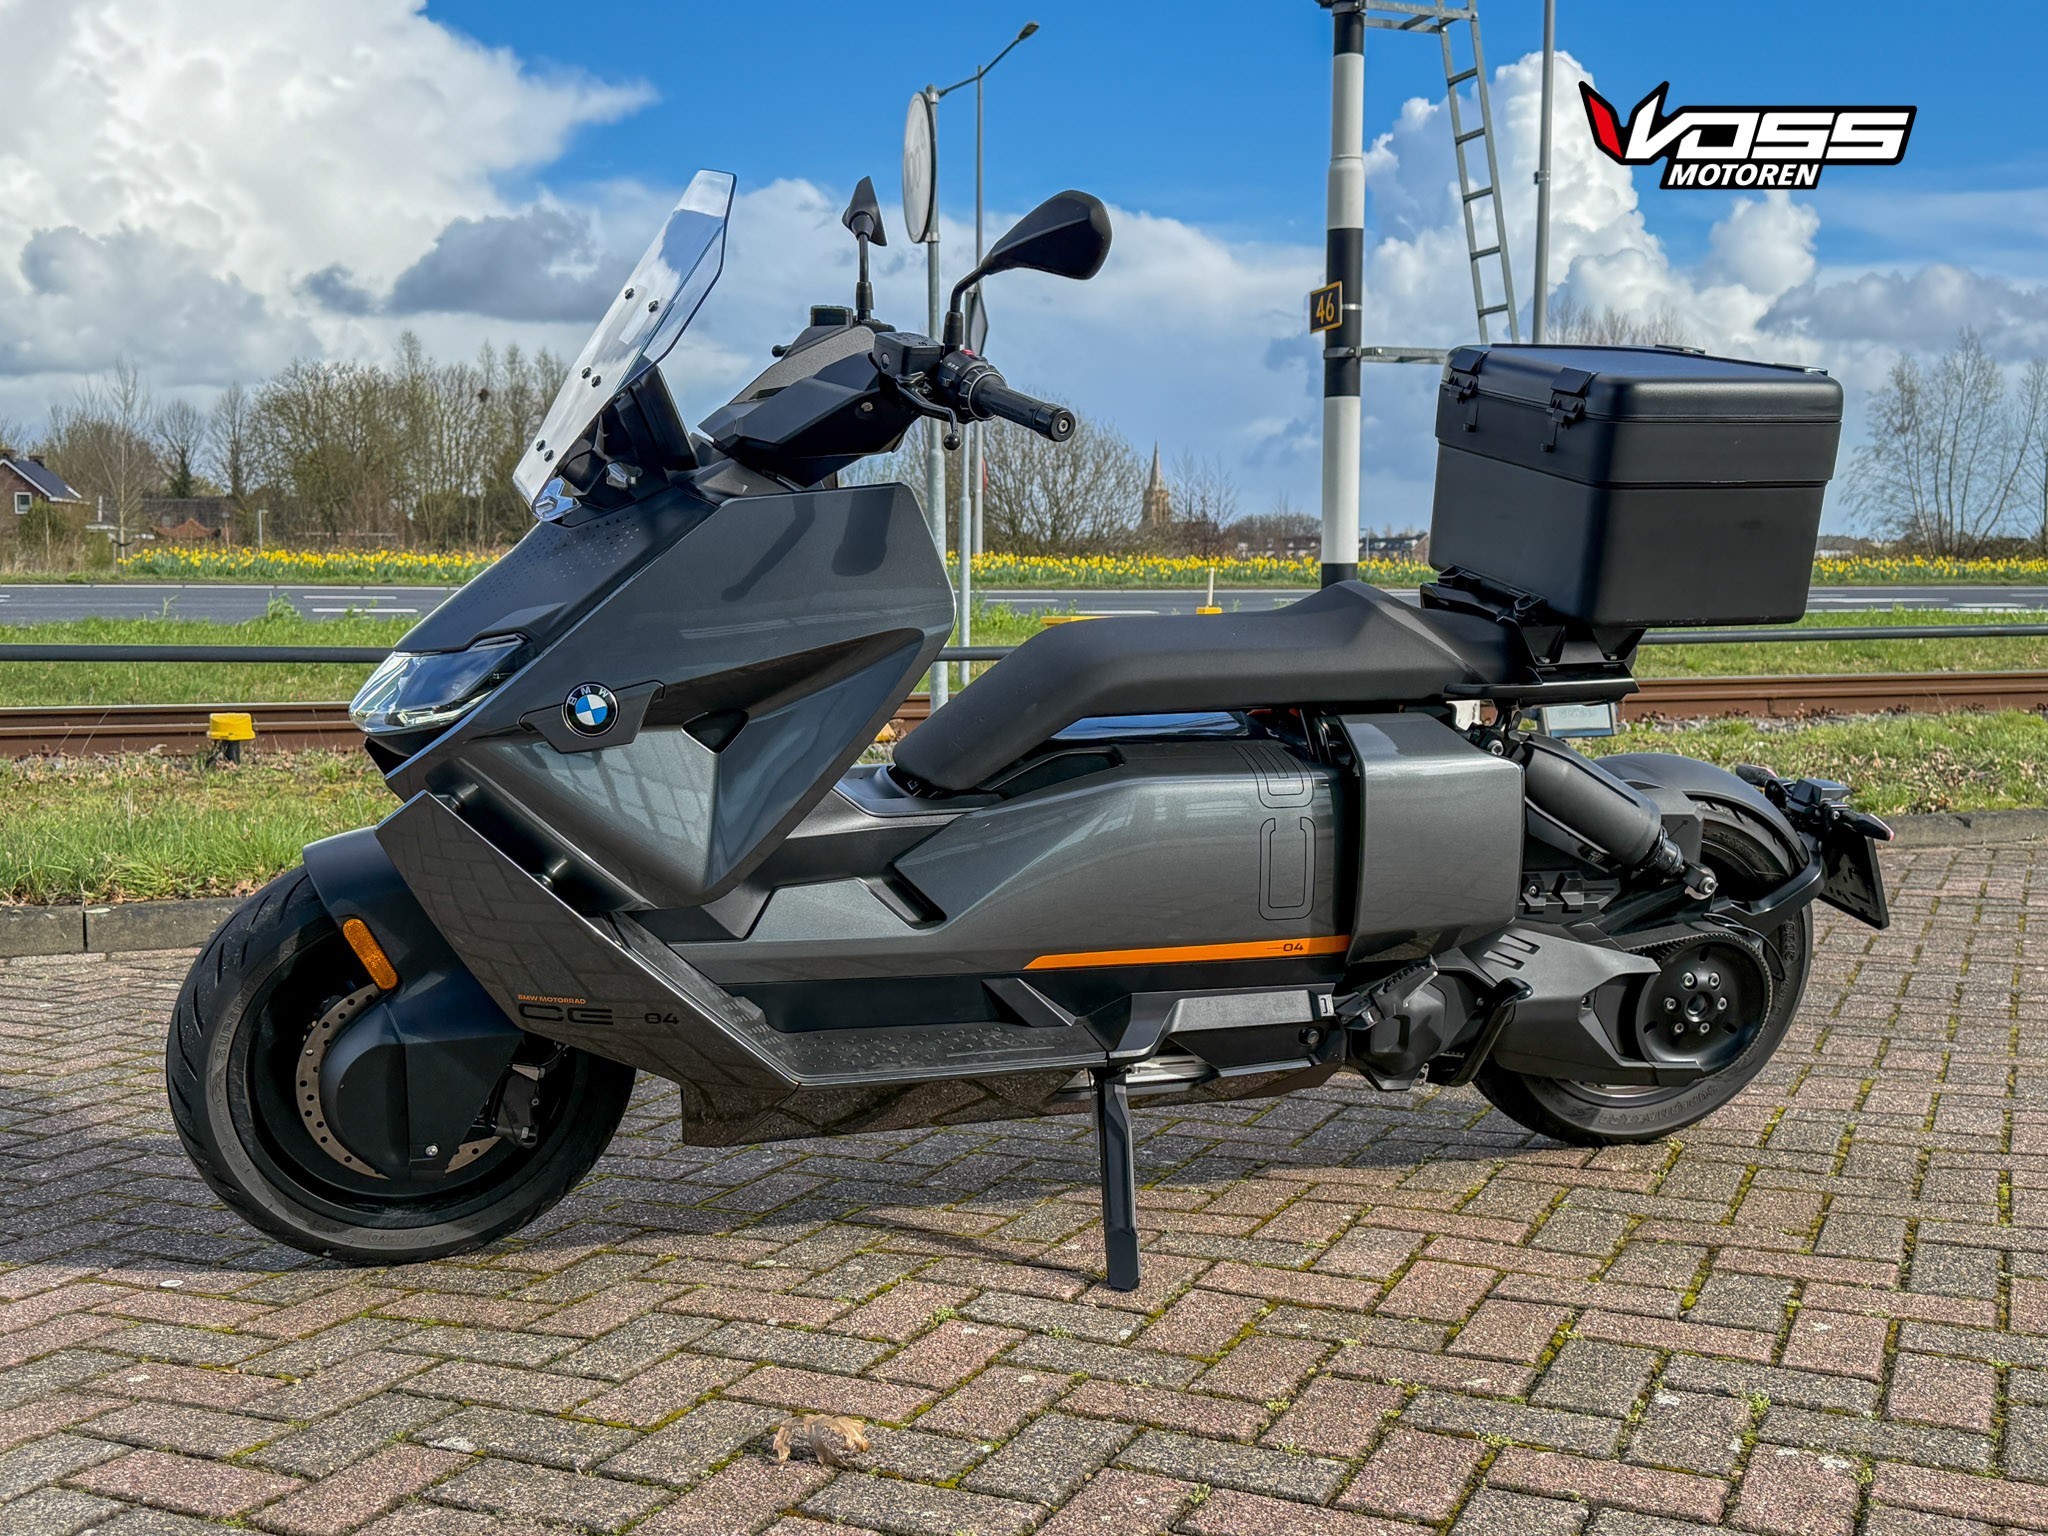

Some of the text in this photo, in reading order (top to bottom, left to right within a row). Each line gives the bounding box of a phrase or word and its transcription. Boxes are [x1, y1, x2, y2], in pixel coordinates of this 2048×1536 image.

[1316, 292, 1335, 324] 46
[568, 685, 609, 706] BMW
[1283, 943, 1304, 952] 04
[539, 995, 587, 1005] MOTORRAD
[518, 1003, 679, 1025] CE 04
